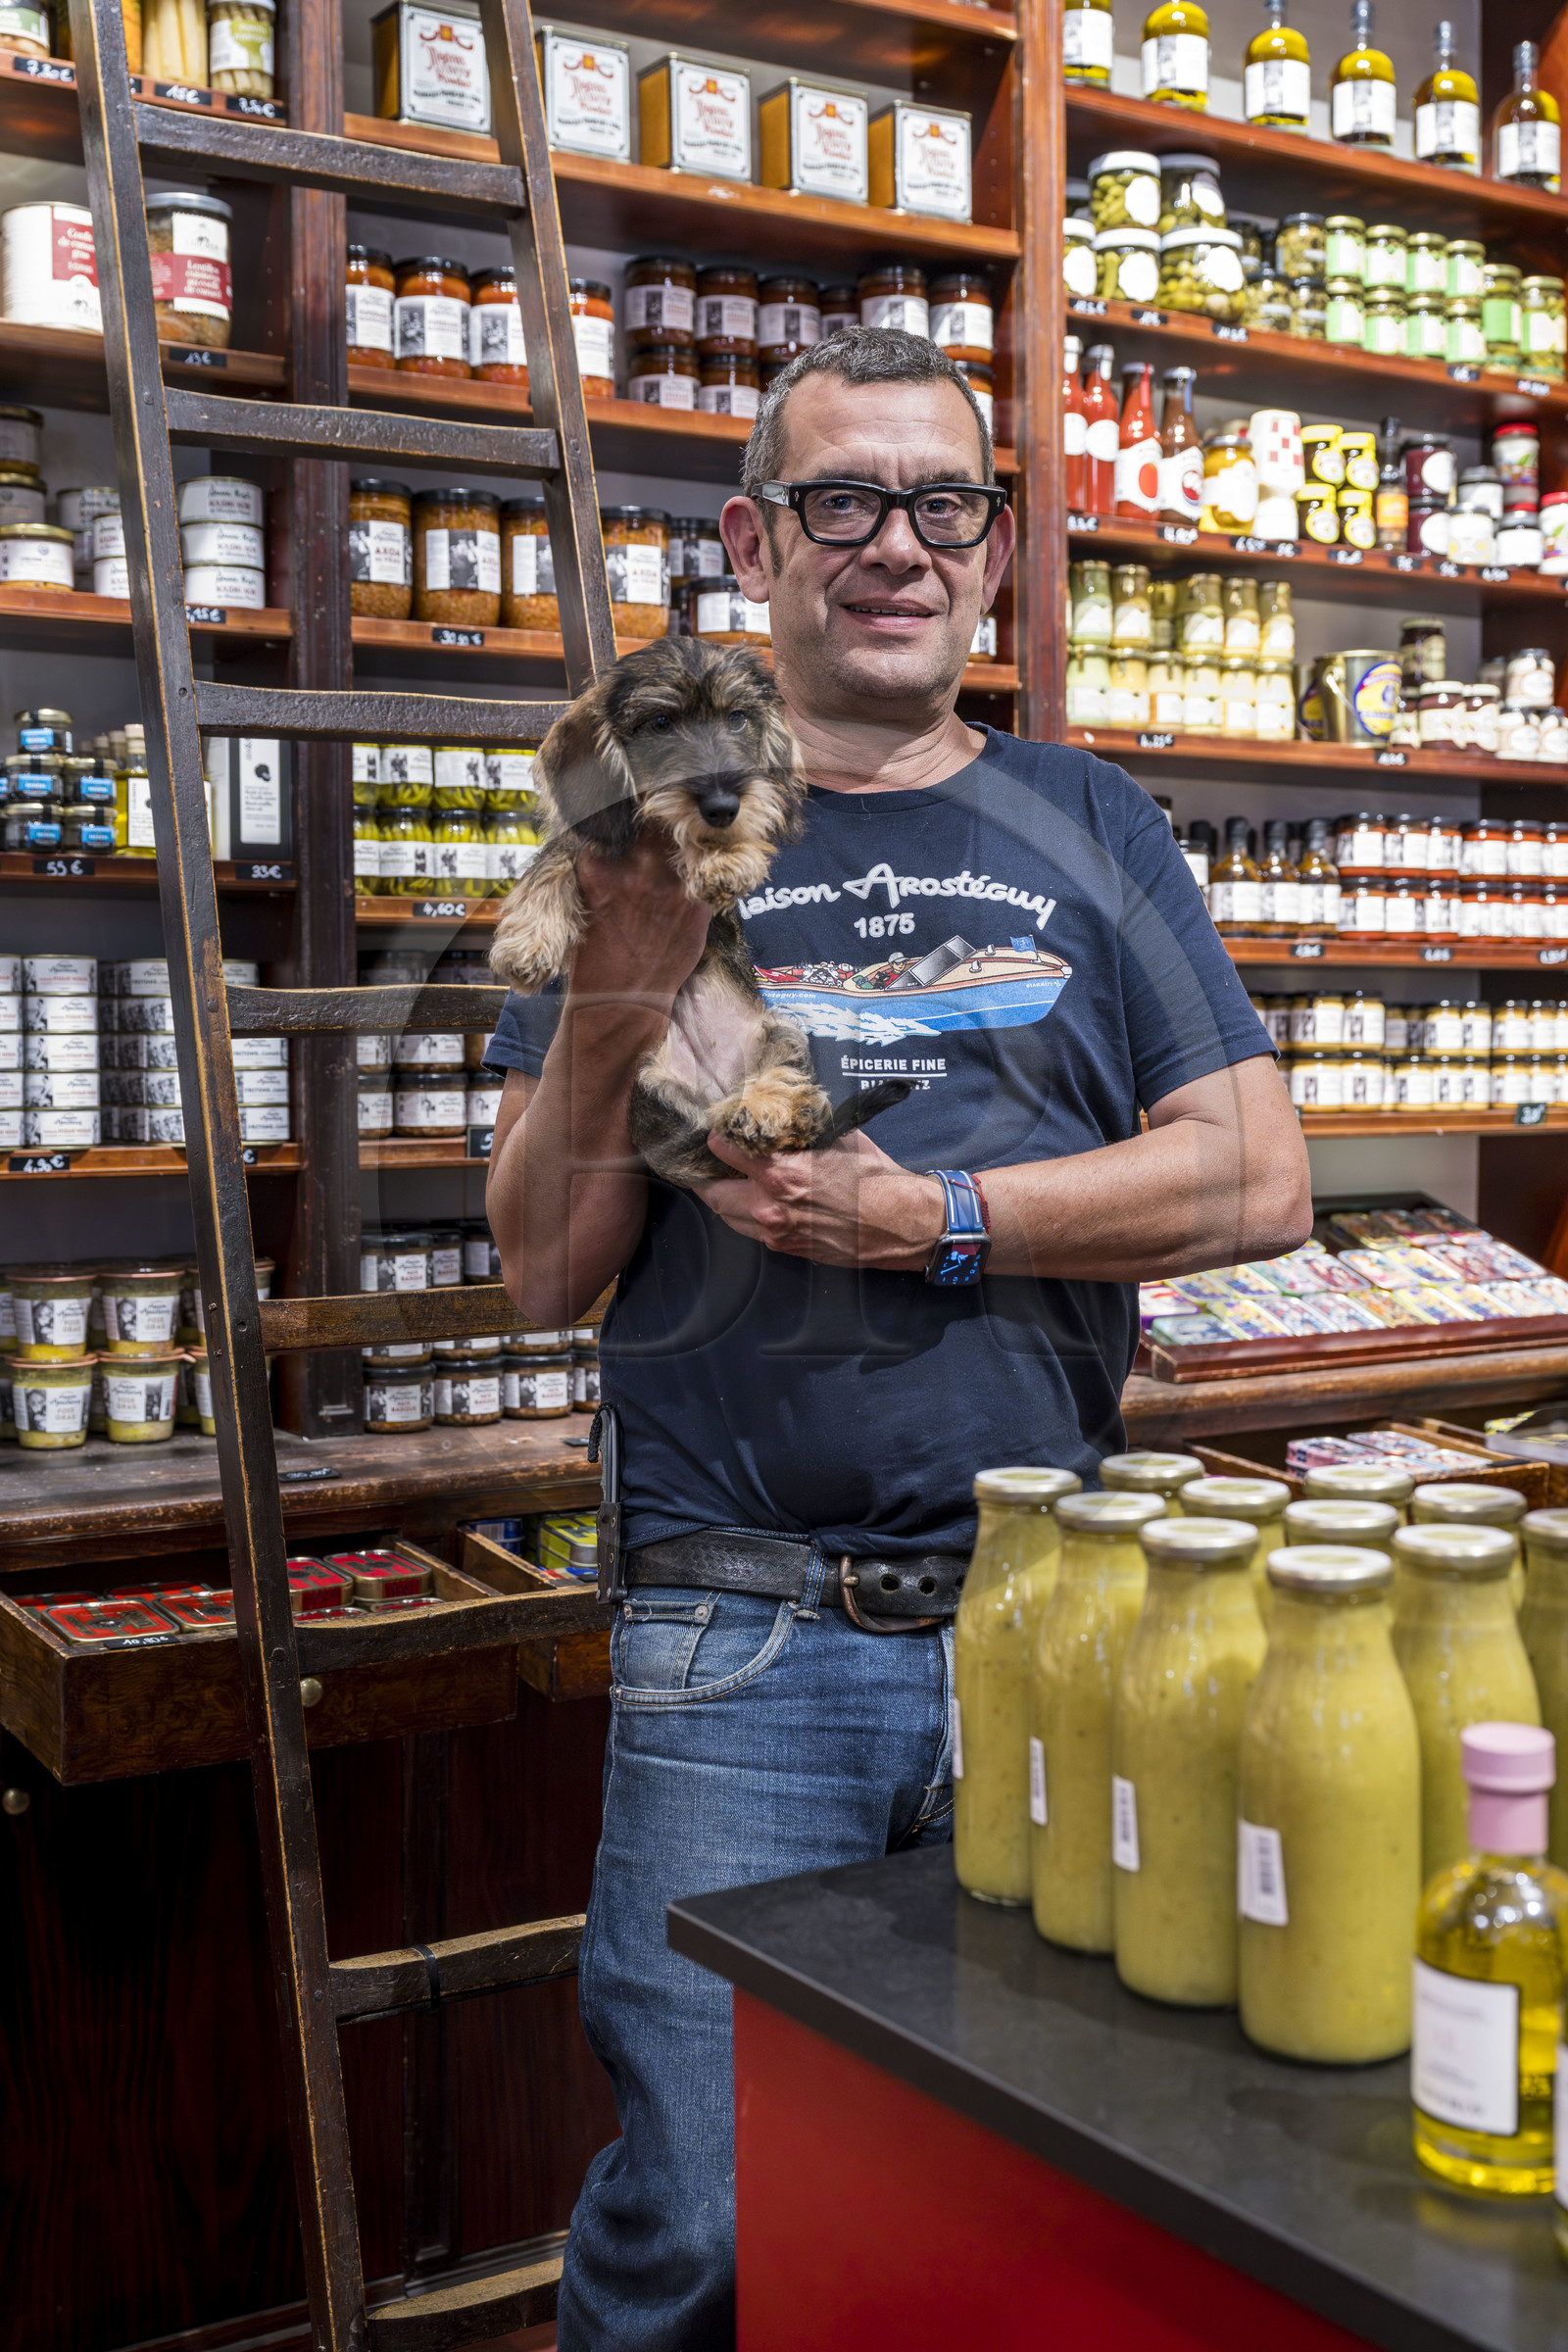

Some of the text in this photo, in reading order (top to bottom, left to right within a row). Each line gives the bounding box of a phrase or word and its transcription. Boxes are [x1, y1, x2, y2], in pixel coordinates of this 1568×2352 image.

[854, 912, 915, 938] 1875
[840, 1054, 947, 1071] ÉPICERIE FINE
